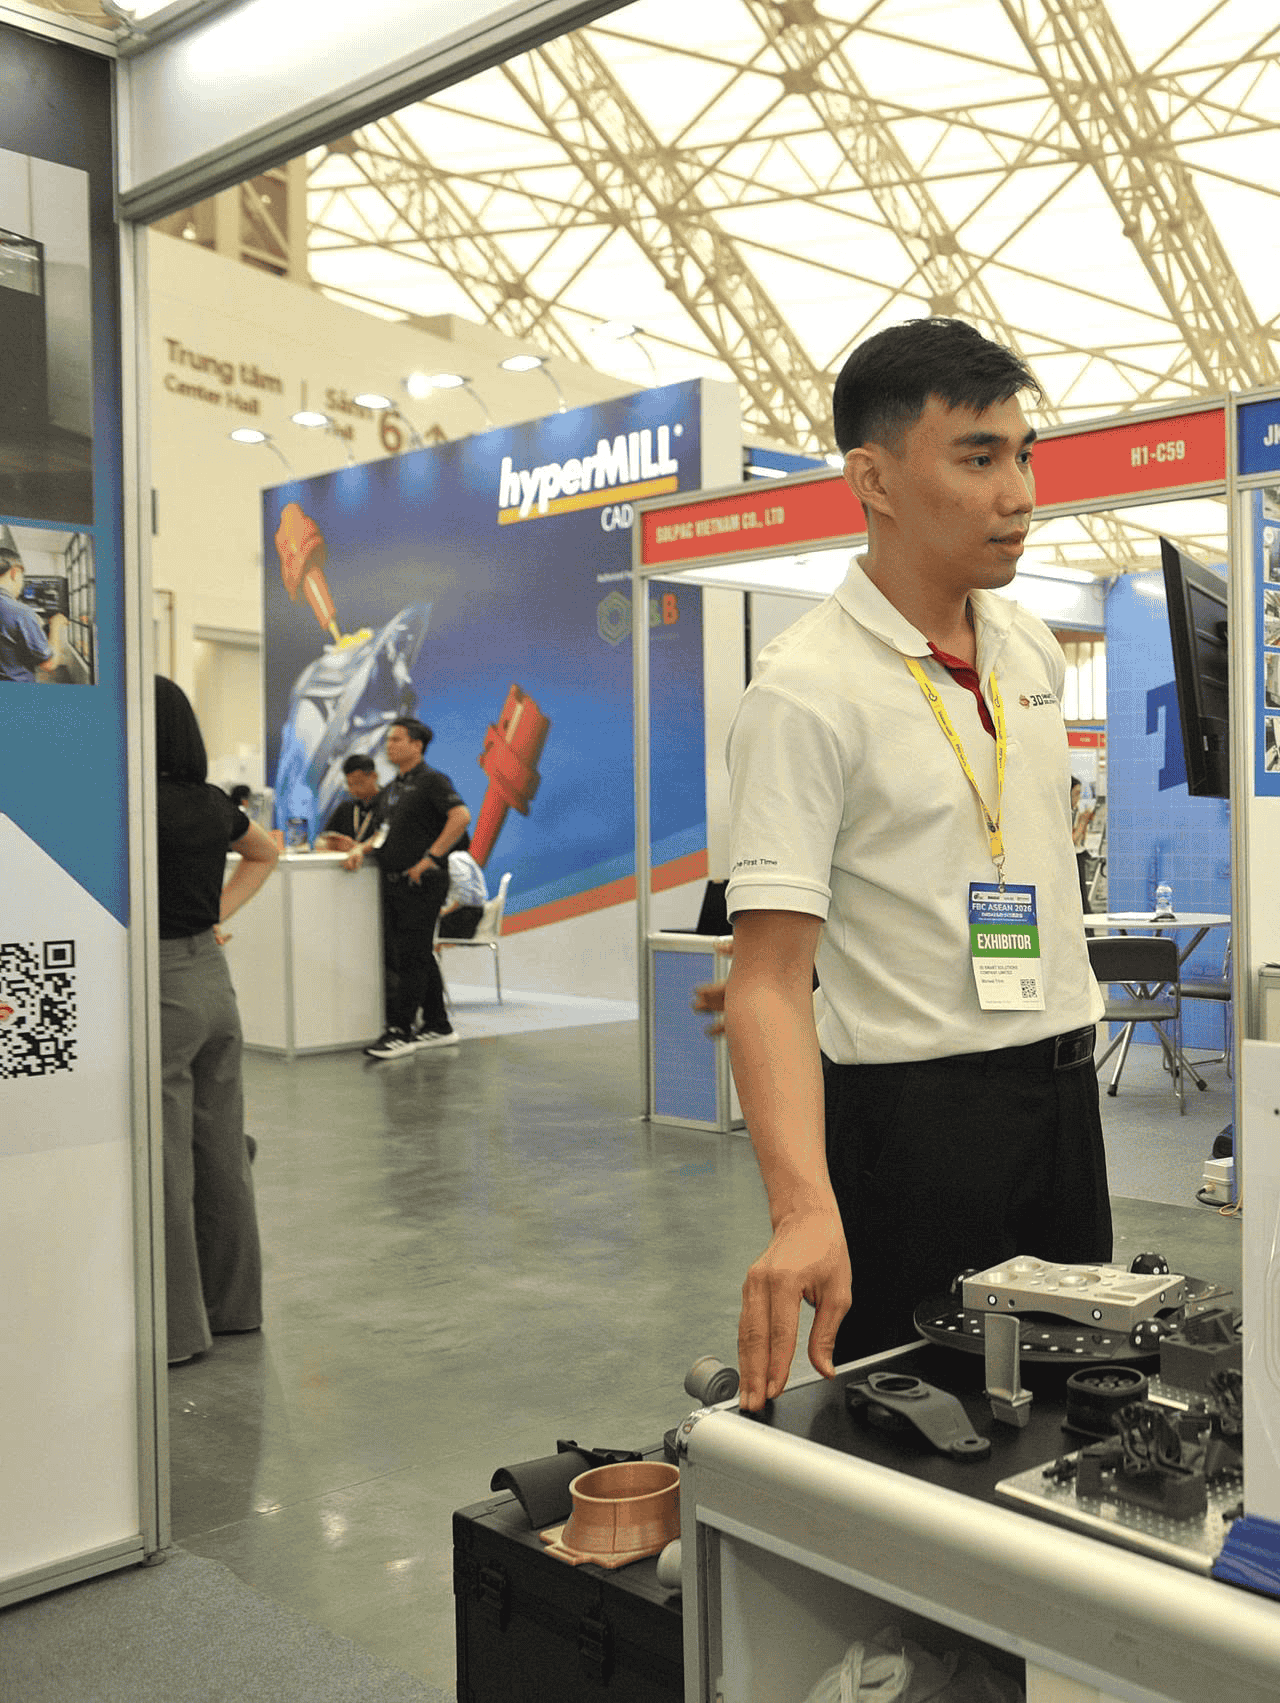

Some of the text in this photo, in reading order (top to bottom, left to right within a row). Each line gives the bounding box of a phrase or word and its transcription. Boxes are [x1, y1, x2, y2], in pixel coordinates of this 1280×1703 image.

[164, 336, 234, 385] Trung
[164, 372, 260, 416] Center Hall
[378, 409, 404, 454] 6
[1131, 440, 1186, 467] H1-C59
[498, 424, 679, 519] hyperMILL
[601, 503, 634, 532] CAD
[695, 512, 741, 537] VIETNAM
[764, 505, 785, 527] LTD
[1030, 694, 1044, 706] 3D
[988, 903, 1013, 912] ASEAN
[1014, 904, 1032, 913] 2026
[977, 933, 1032, 950] EXHIBITOR
